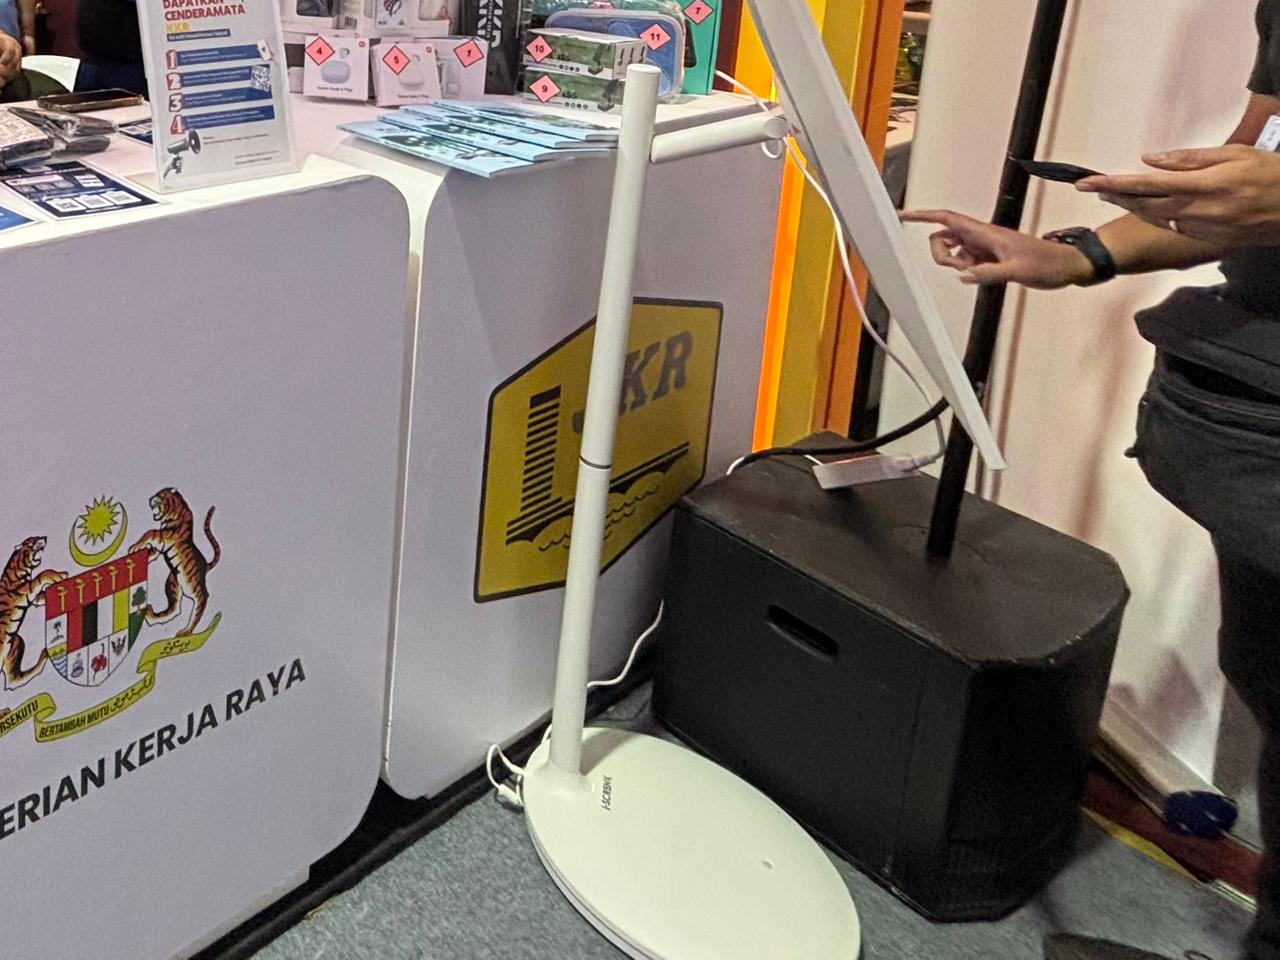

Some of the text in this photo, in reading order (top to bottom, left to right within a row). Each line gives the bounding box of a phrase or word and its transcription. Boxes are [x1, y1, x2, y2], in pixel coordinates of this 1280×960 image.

[165, 4, 246, 21] CENDERAMATA
[695, 7, 701, 15] 7
[166, 21, 190, 33] KKR
[650, 33, 660, 41] 11
[535, 44, 545, 53] 10
[166, 49, 178, 70] 1
[394, 56, 400, 64] 5
[166, 72, 182, 91] 2
[541, 85, 548, 93] 9
[168, 93, 184, 113] 3
[170, 114, 186, 135] 4
[38, 706, 110, 738] BERTAMBAH MUTU
[113, 704, 218, 779] KERJA
[225, 658, 306, 721] RAYA
